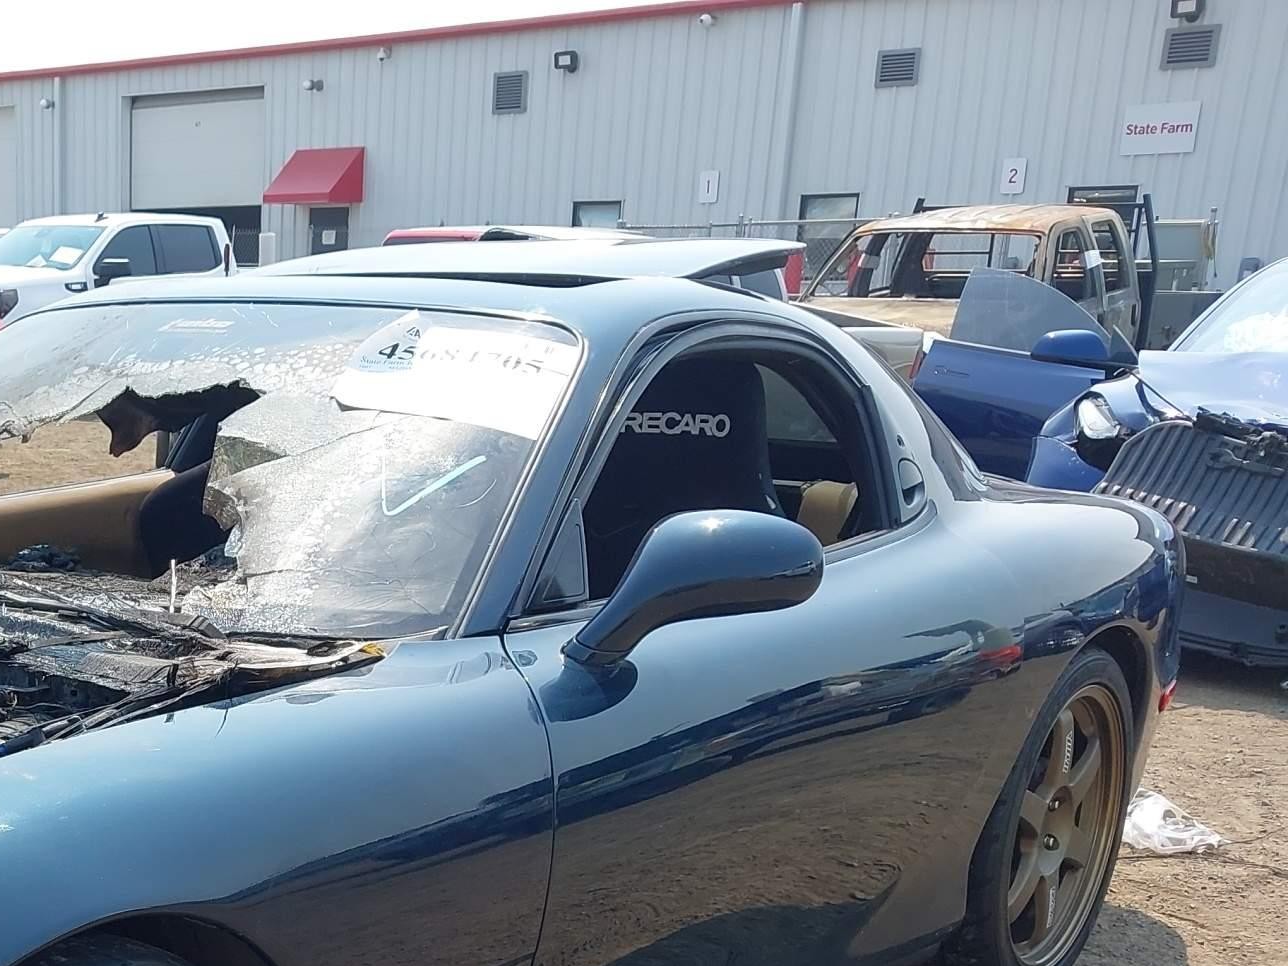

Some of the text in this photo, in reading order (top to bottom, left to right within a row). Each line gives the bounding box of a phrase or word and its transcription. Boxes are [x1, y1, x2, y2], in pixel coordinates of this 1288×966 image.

[1126, 122, 1193, 136] State Farm
[1008, 168, 1018, 184] 2
[619, 411, 731, 438] RECARO
